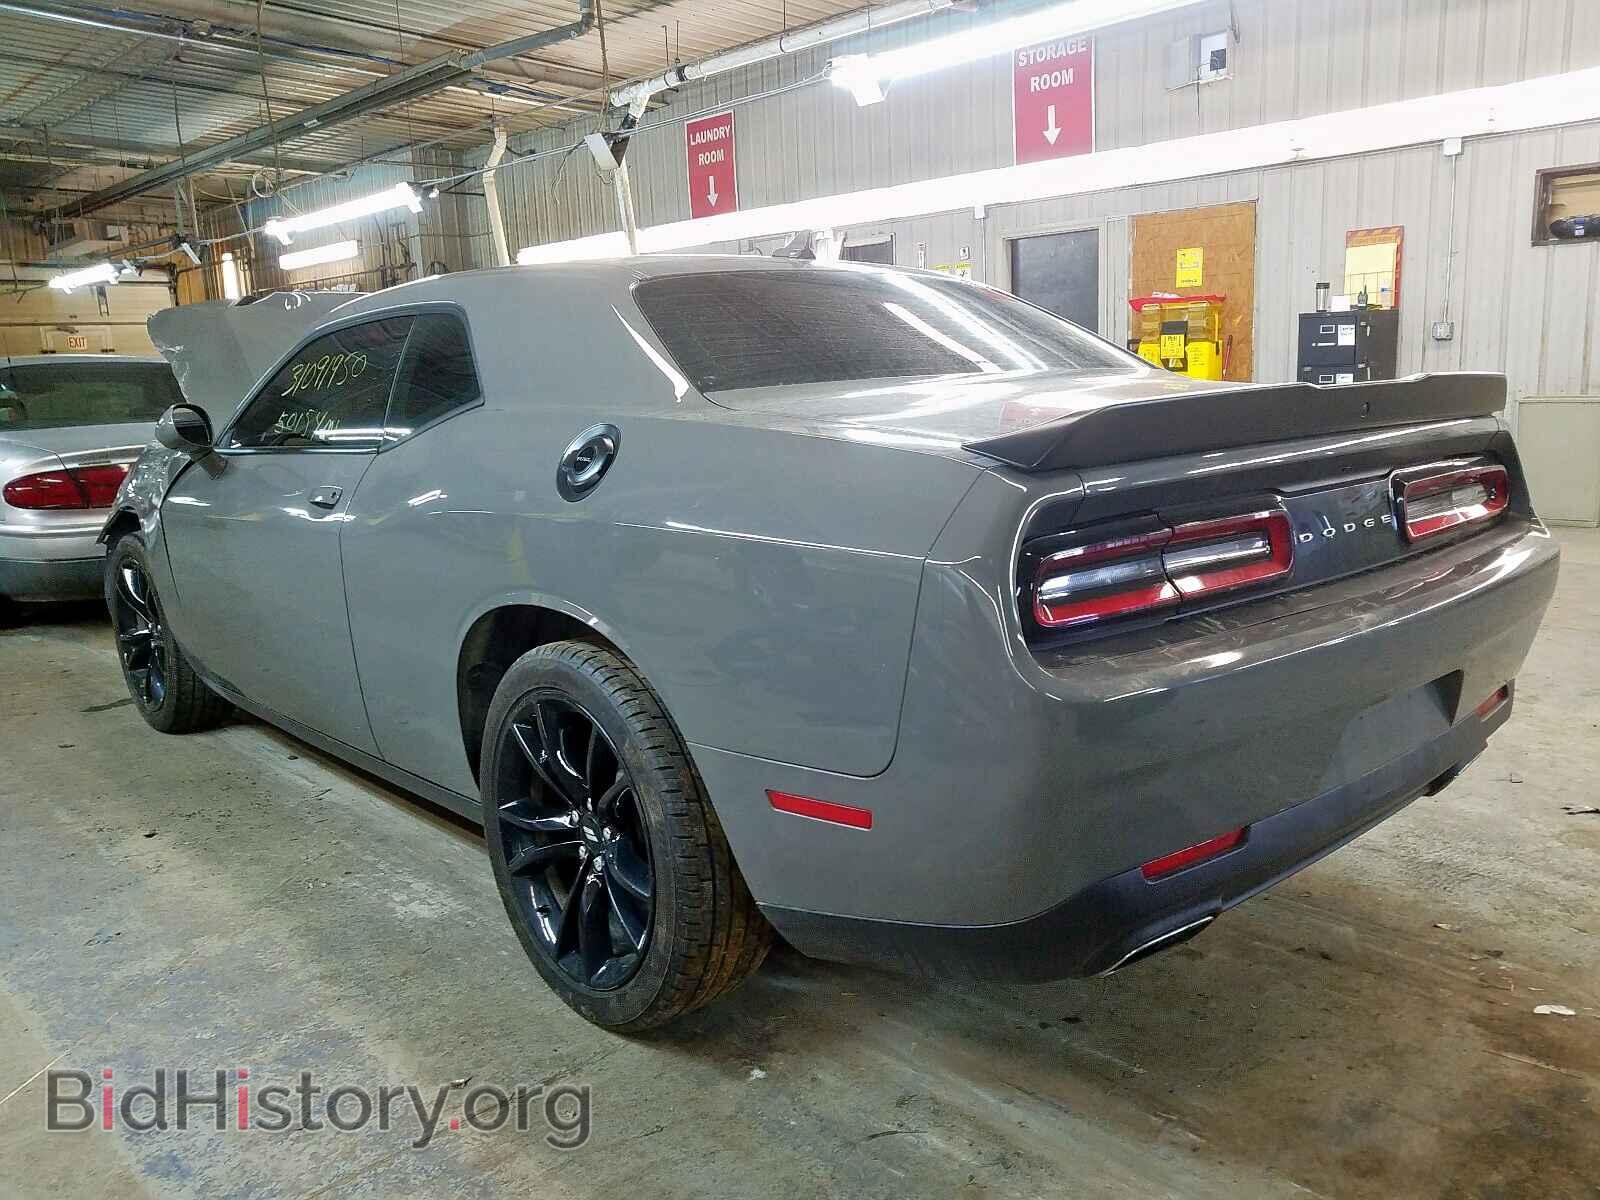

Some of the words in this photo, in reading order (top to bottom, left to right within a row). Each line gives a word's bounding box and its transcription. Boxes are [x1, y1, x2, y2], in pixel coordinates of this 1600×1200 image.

[1018, 36, 1088, 68] STORAGE
[1030, 67, 1074, 93] ROOM
[690, 125, 731, 146] LAUNDRY
[698, 148, 725, 166] ROOM
[68, 336, 86, 348] EXIT
[1299, 514, 1392, 543] DODGE
